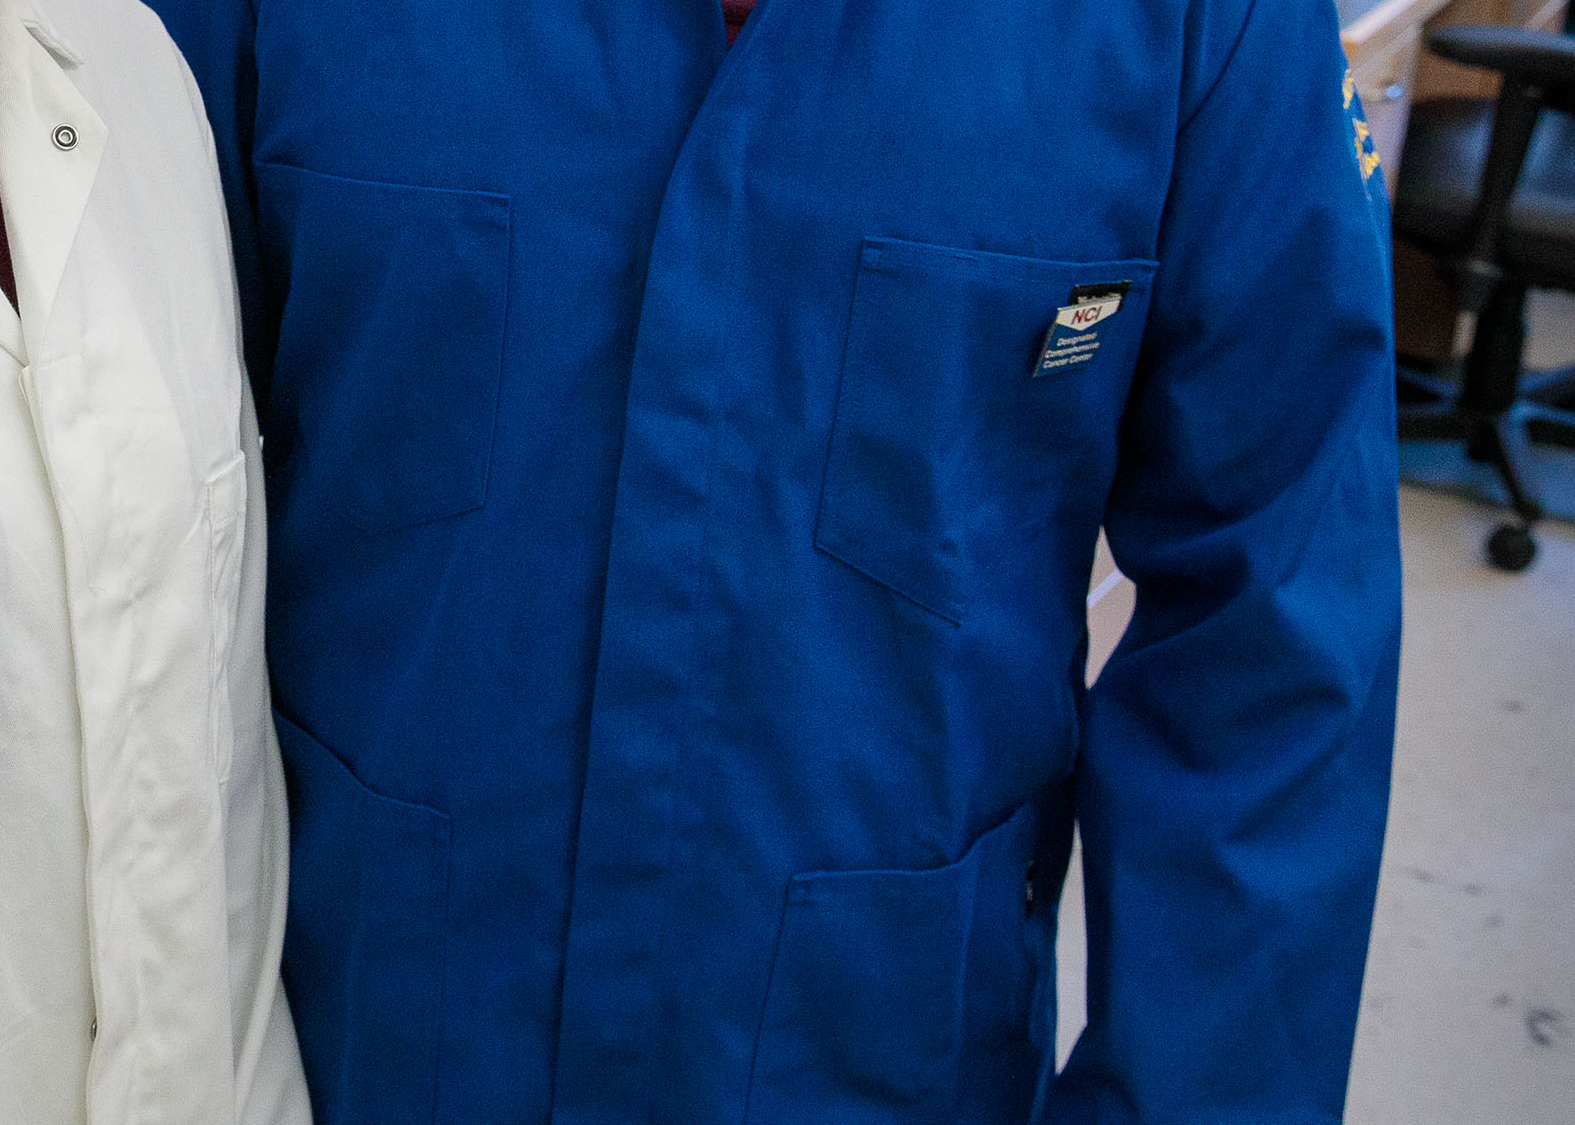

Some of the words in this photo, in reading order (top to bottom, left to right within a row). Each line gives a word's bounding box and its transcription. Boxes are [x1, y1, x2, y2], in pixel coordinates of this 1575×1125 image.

[1070, 306, 1103, 325] NCI
[1056, 332, 1098, 347] Designated
[1045, 342, 1101, 359] Comprehensive
[1042, 357, 1069, 369] Cancer
[1068, 354, 1094, 365] Center
